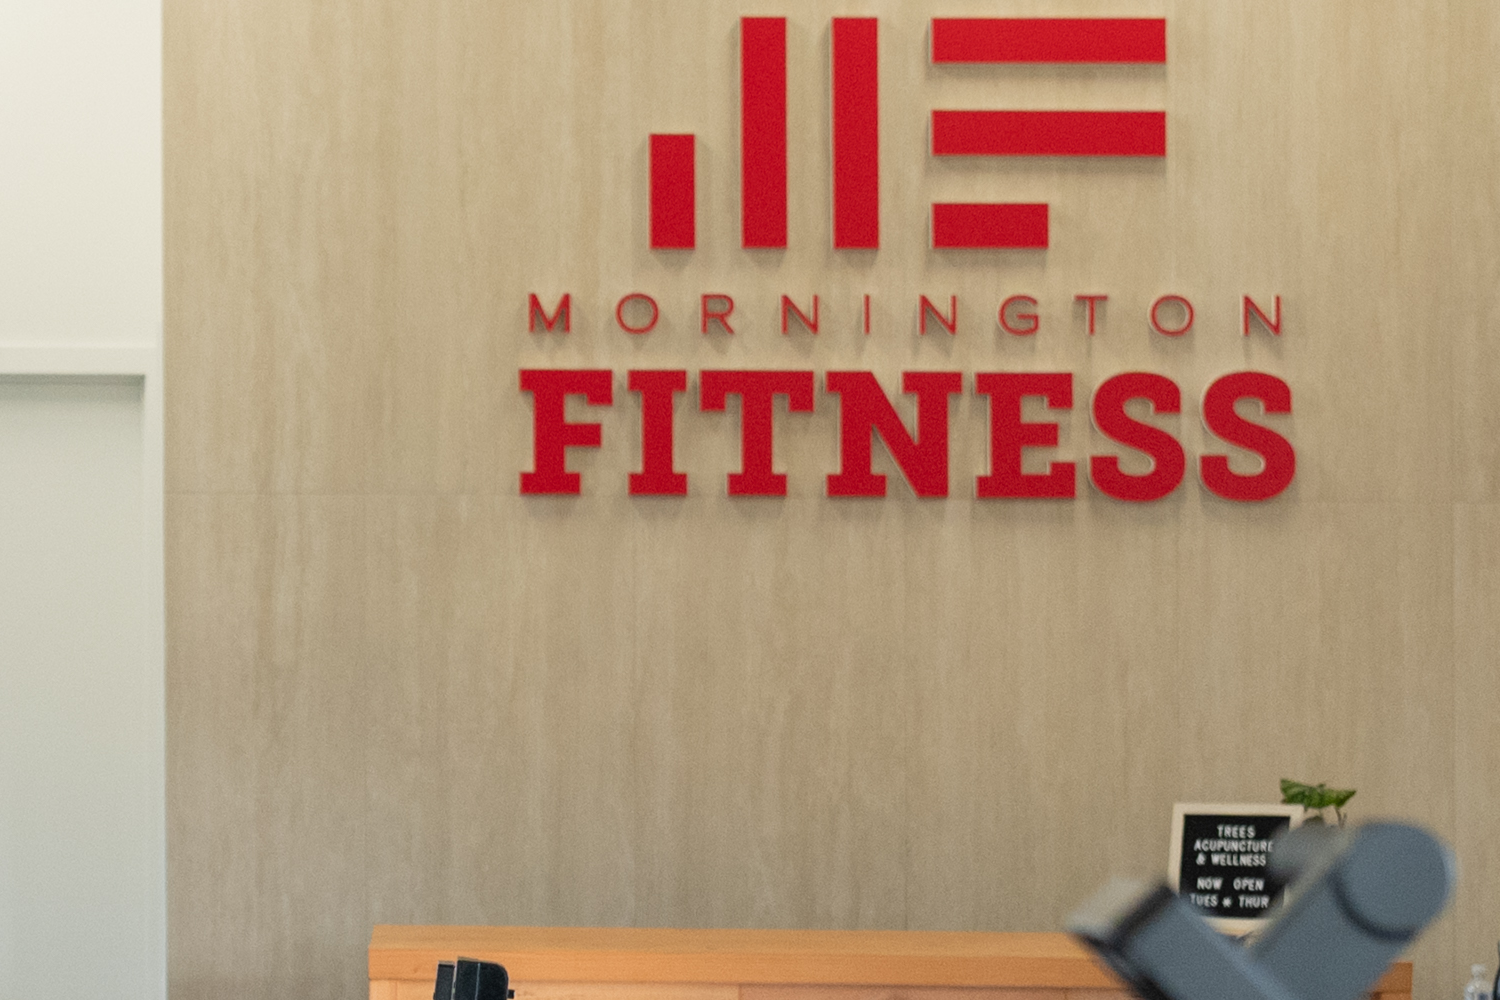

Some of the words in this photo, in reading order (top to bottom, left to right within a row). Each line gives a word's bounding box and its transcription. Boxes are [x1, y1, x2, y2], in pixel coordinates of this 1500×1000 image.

[528, 293, 1283, 336] MORNINGTON
[519, 369, 1296, 501] FITNESS
[1217, 825, 1256, 838] TREES
[1194, 839, 1274, 852] ACUPUNCTURE
[1196, 853, 1206, 865] &
[1211, 853, 1267, 867] WELLNESS
[1197, 877, 1223, 890] NOW
[1233, 878, 1264, 891] OPEN
[1190, 893, 1218, 907] TUES
[1239, 895, 1270, 908] THUR
